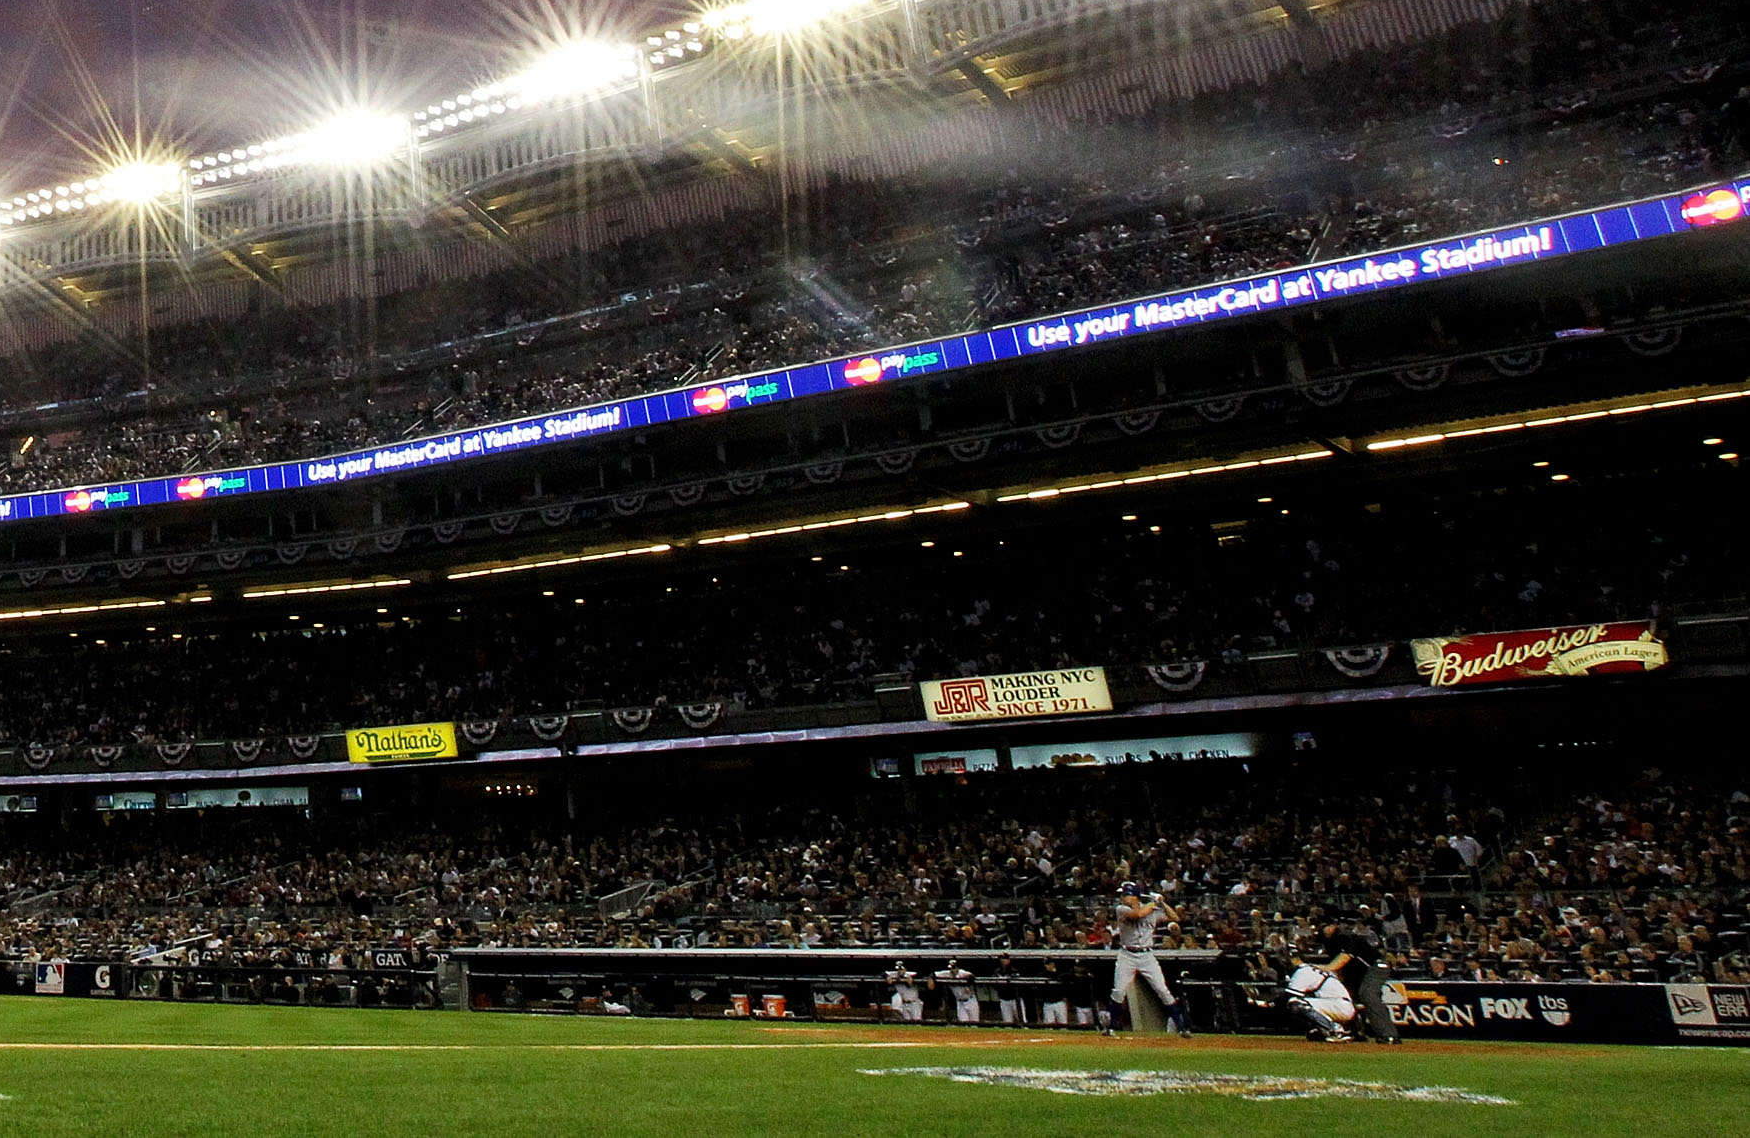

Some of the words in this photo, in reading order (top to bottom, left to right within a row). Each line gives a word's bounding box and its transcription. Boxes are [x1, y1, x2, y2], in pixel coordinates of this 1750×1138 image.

[1027, 323, 1071, 348] Use
[1074, 312, 1131, 348] your
[1133, 279, 1278, 325] MasterCard
[1282, 274, 1313, 300] at
[1315, 258, 1416, 293] Yankee
[1420, 226, 1553, 274] Stadium!
[308, 462, 336, 480] Use
[336, 457, 373, 480] your
[375, 438, 462, 469] MasterCard
[463, 435, 481, 453] at
[482, 424, 542, 449] Yankee
[544, 407, 621, 439] Stadium!
[1431, 623, 1608, 687] Budweiser
[1566, 647, 1620, 669] American
[1623, 647, 1661, 659] Lager
[989, 672, 1056, 690] MAKING
[1061, 669, 1096, 684] NYC
[993, 686, 1061, 703] LOUDER
[996, 699, 1046, 717] SINCE
[355, 727, 446, 754] Nathan's
[1105, 754, 1142, 765] SLIDRS
[1479, 997, 1534, 1020] FOX
[1538, 995, 1569, 1010] tbs
[1713, 994, 1745, 1006] NEW
[1387, 1004, 1476, 1027] EASON
